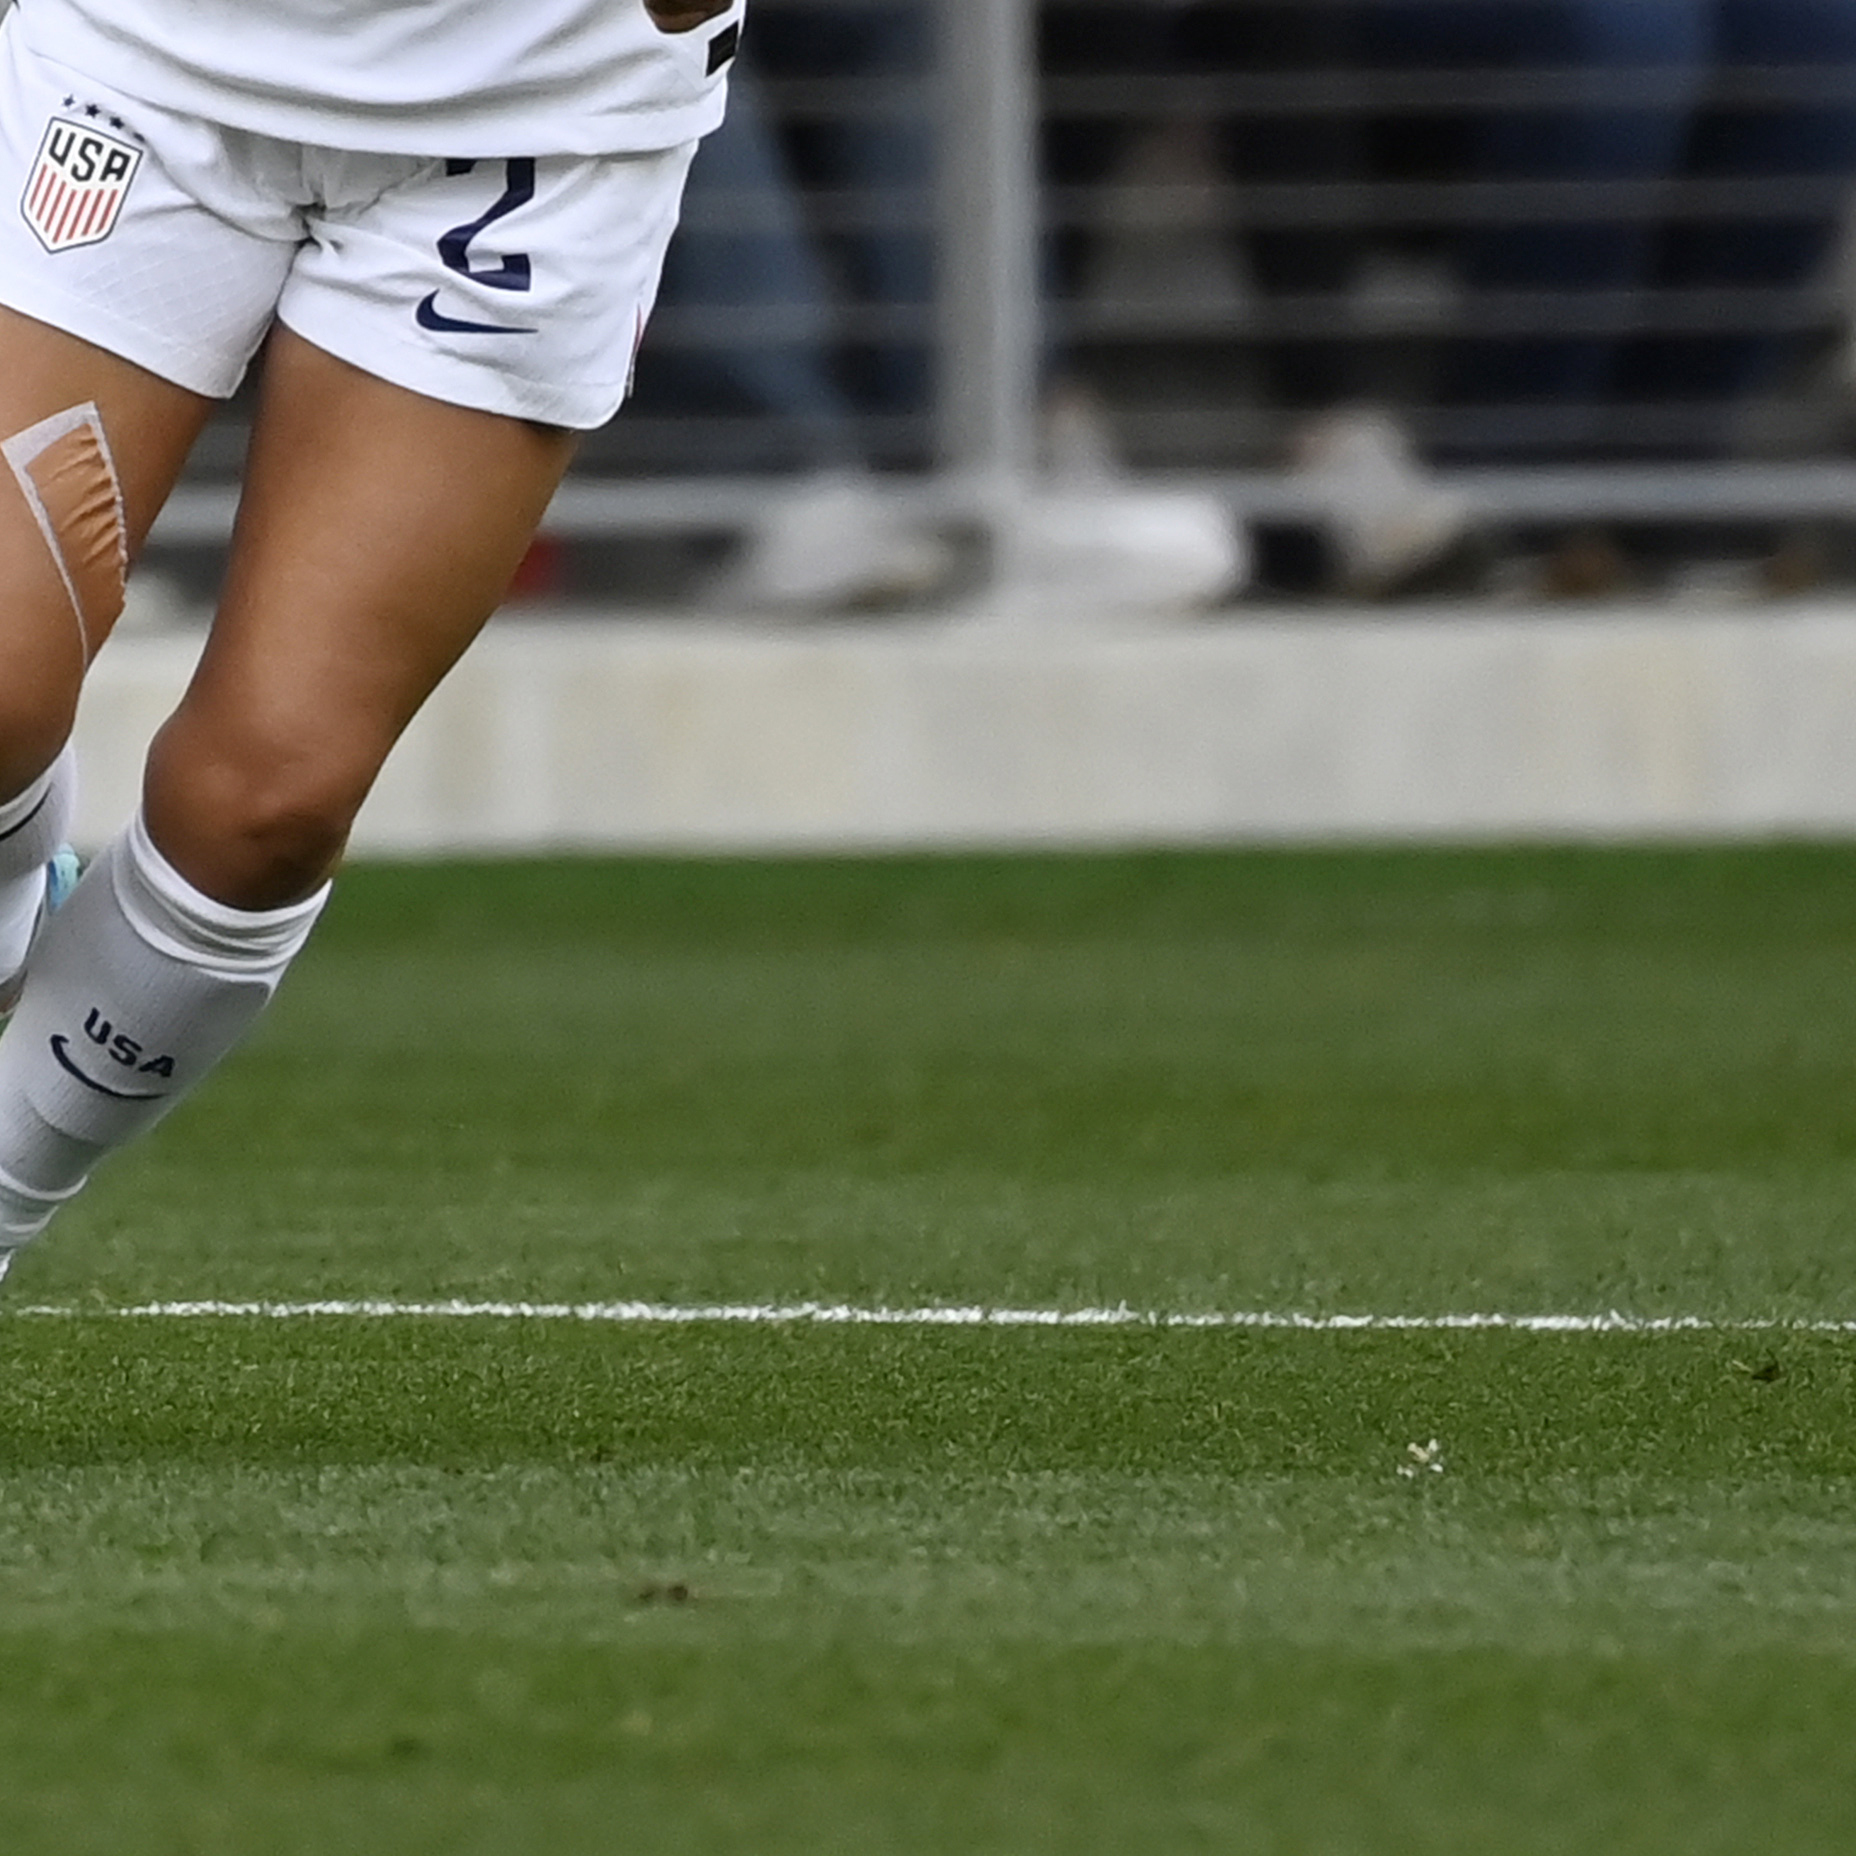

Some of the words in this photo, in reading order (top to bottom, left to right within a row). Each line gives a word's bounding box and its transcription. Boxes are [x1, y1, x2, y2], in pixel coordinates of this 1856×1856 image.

[48, 126, 132, 184] USA
[436, 156, 535, 293] 2
[83, 1006, 176, 1078] USA
